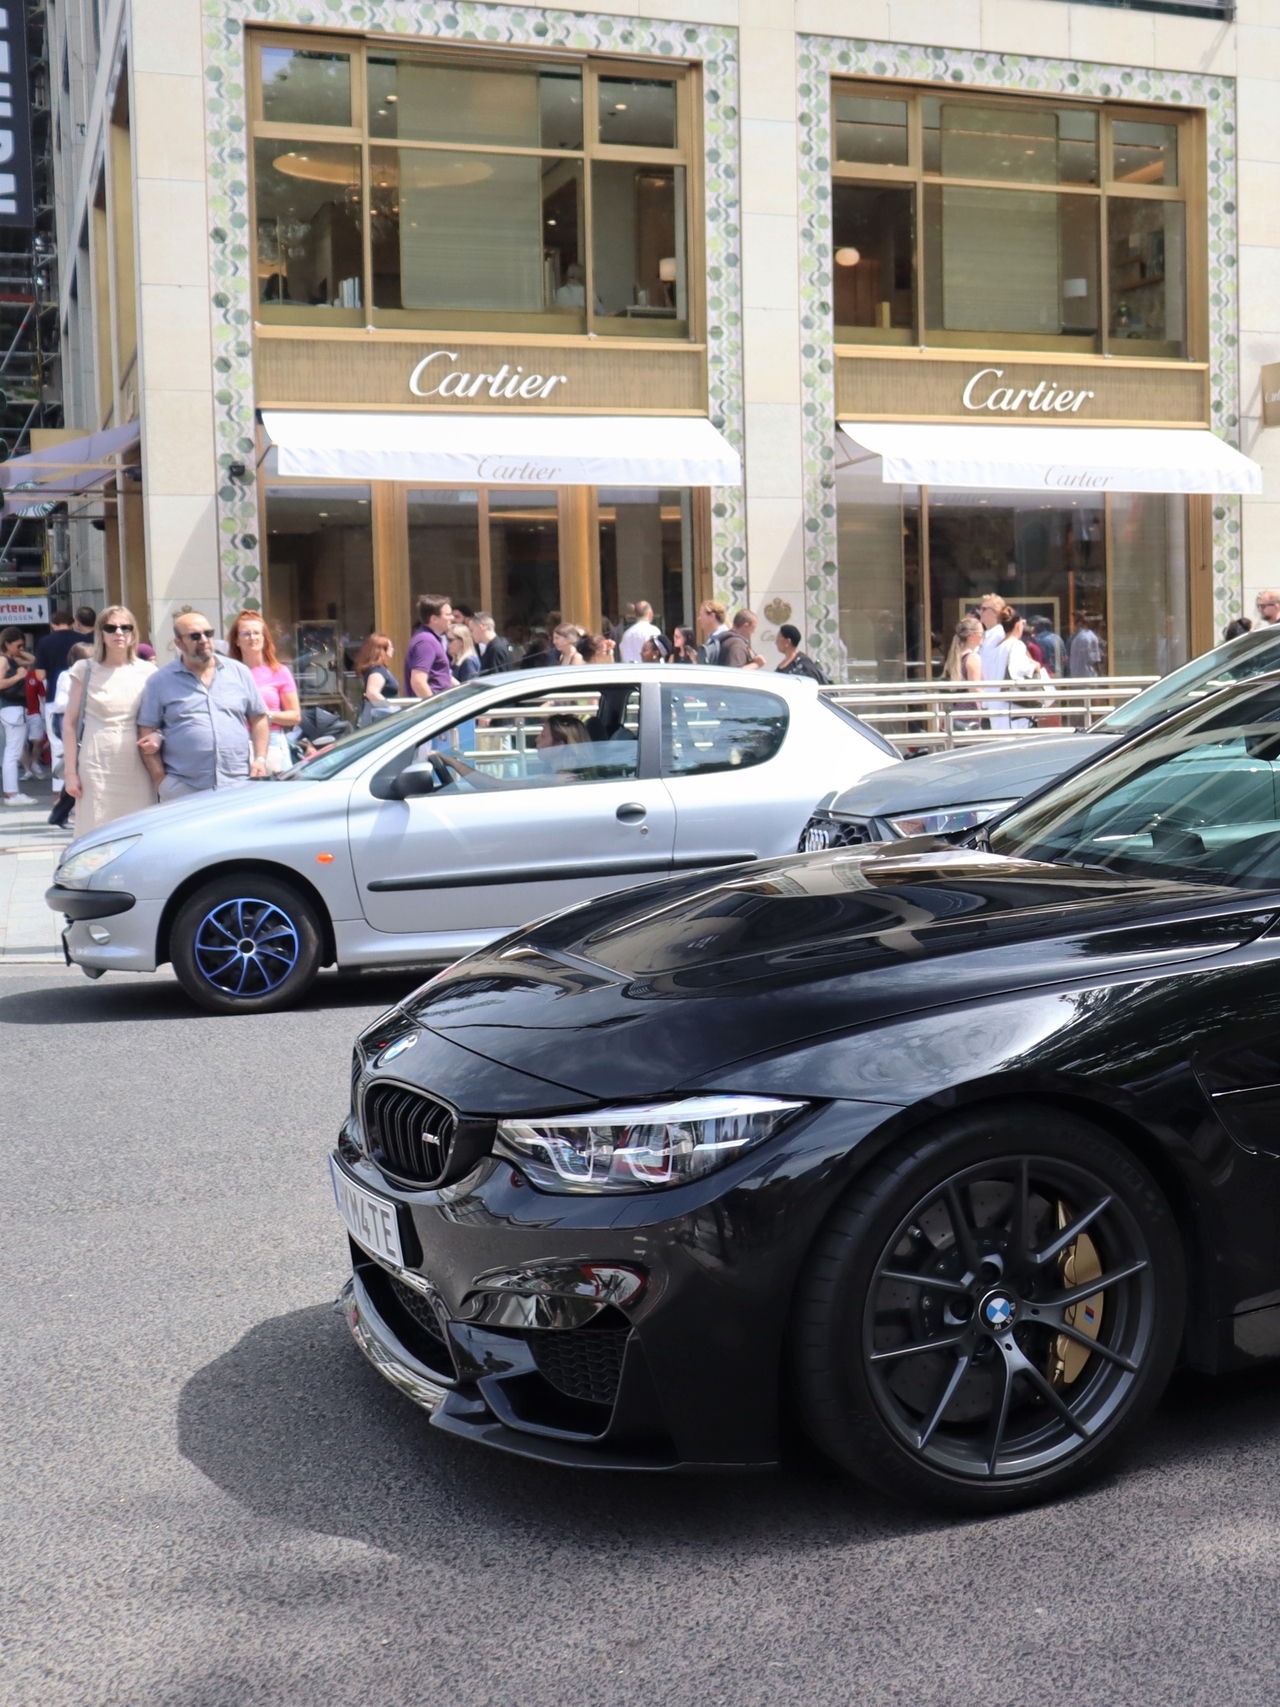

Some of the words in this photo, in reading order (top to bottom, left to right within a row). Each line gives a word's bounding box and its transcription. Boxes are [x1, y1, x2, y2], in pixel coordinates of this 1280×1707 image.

[408, 350, 568, 399] Cartier
[962, 368, 1095, 412] Cartier
[477, 455, 562, 480] Cartier
[1044, 464, 1114, 488] Cartier
